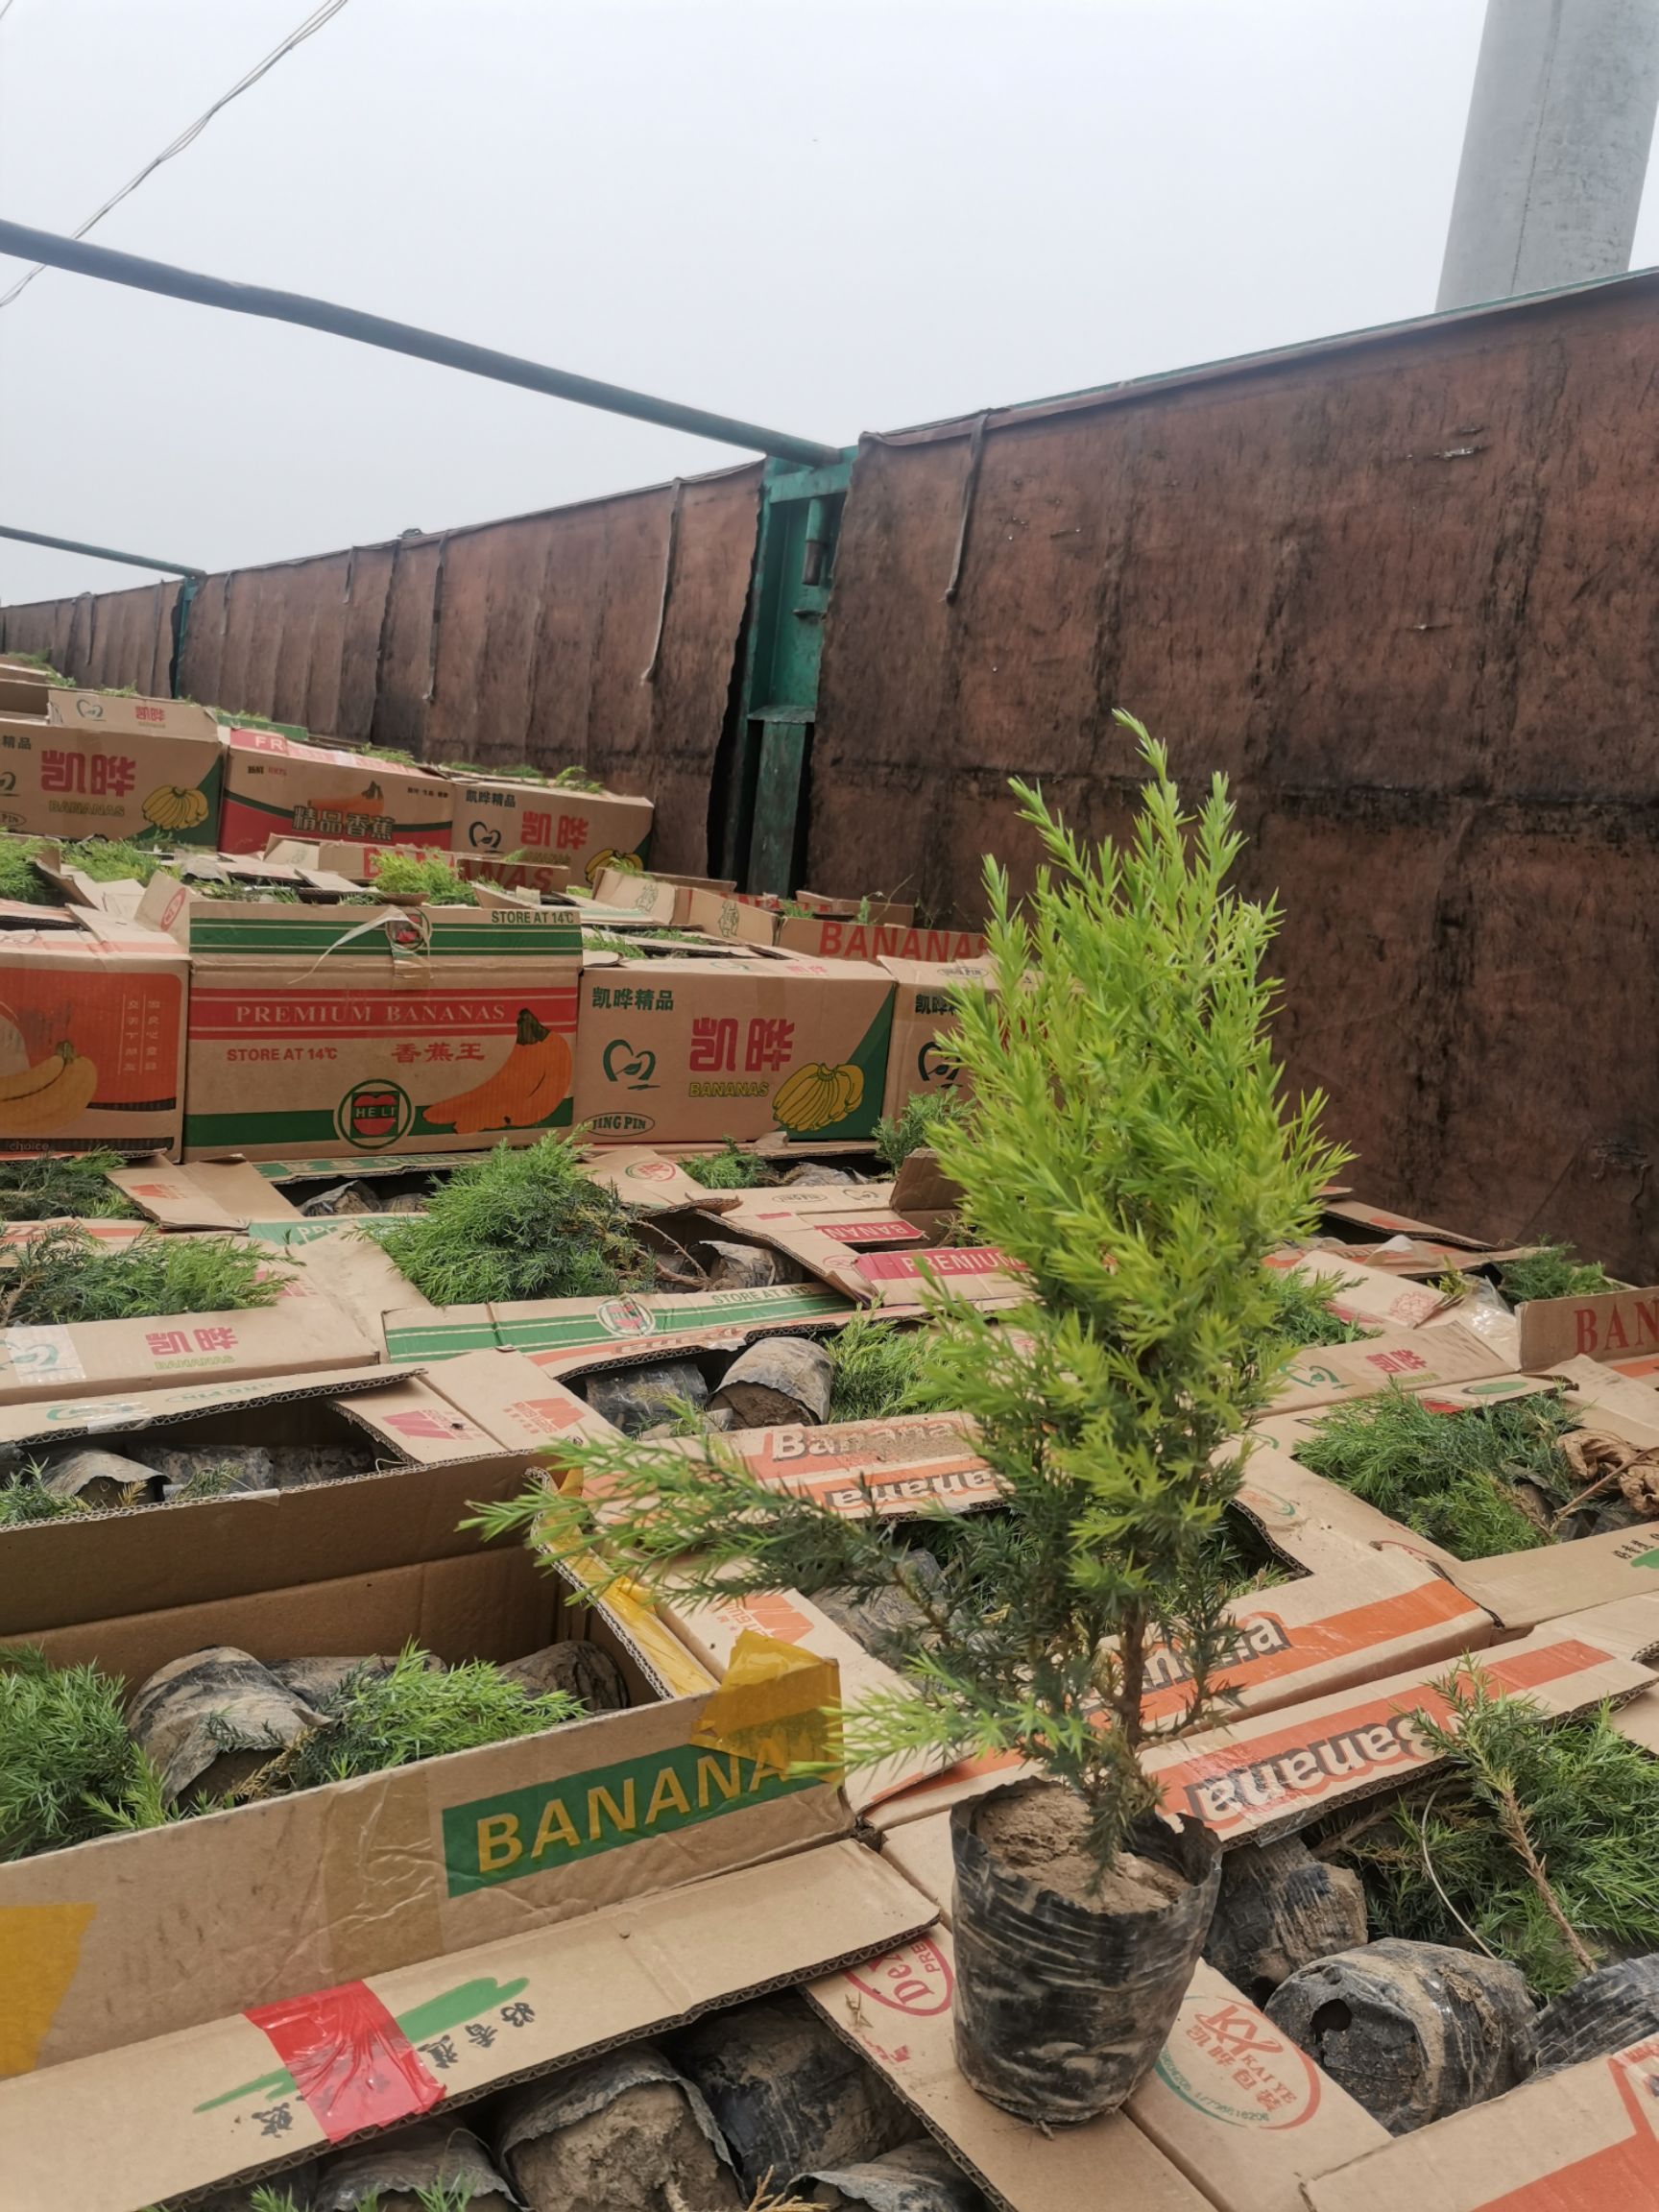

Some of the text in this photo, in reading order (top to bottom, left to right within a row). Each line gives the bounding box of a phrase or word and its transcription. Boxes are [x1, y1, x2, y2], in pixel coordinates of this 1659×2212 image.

[3, 735, 31, 750] 精品
[292, 805, 395, 840] 精品香蕉
[492, 911, 530, 925] STORE
[534, 911, 549, 925] AT
[236, 1005, 505, 1023] PREMIUM BANANAS
[227, 1048, 279, 1062] STORE
[283, 1048, 304, 1060] AT
[392, 1043, 485, 1063] 香蕉王
[688, 1082, 769, 1098] BANANAS
[591, 1116, 646, 1130] JING PIN
[712, 1289, 759, 1304] STORE
[761, 1288, 782, 1299] AT
[825, 1468, 1000, 1510] anana
[1241, 2055, 1297, 2104] KAI YE
